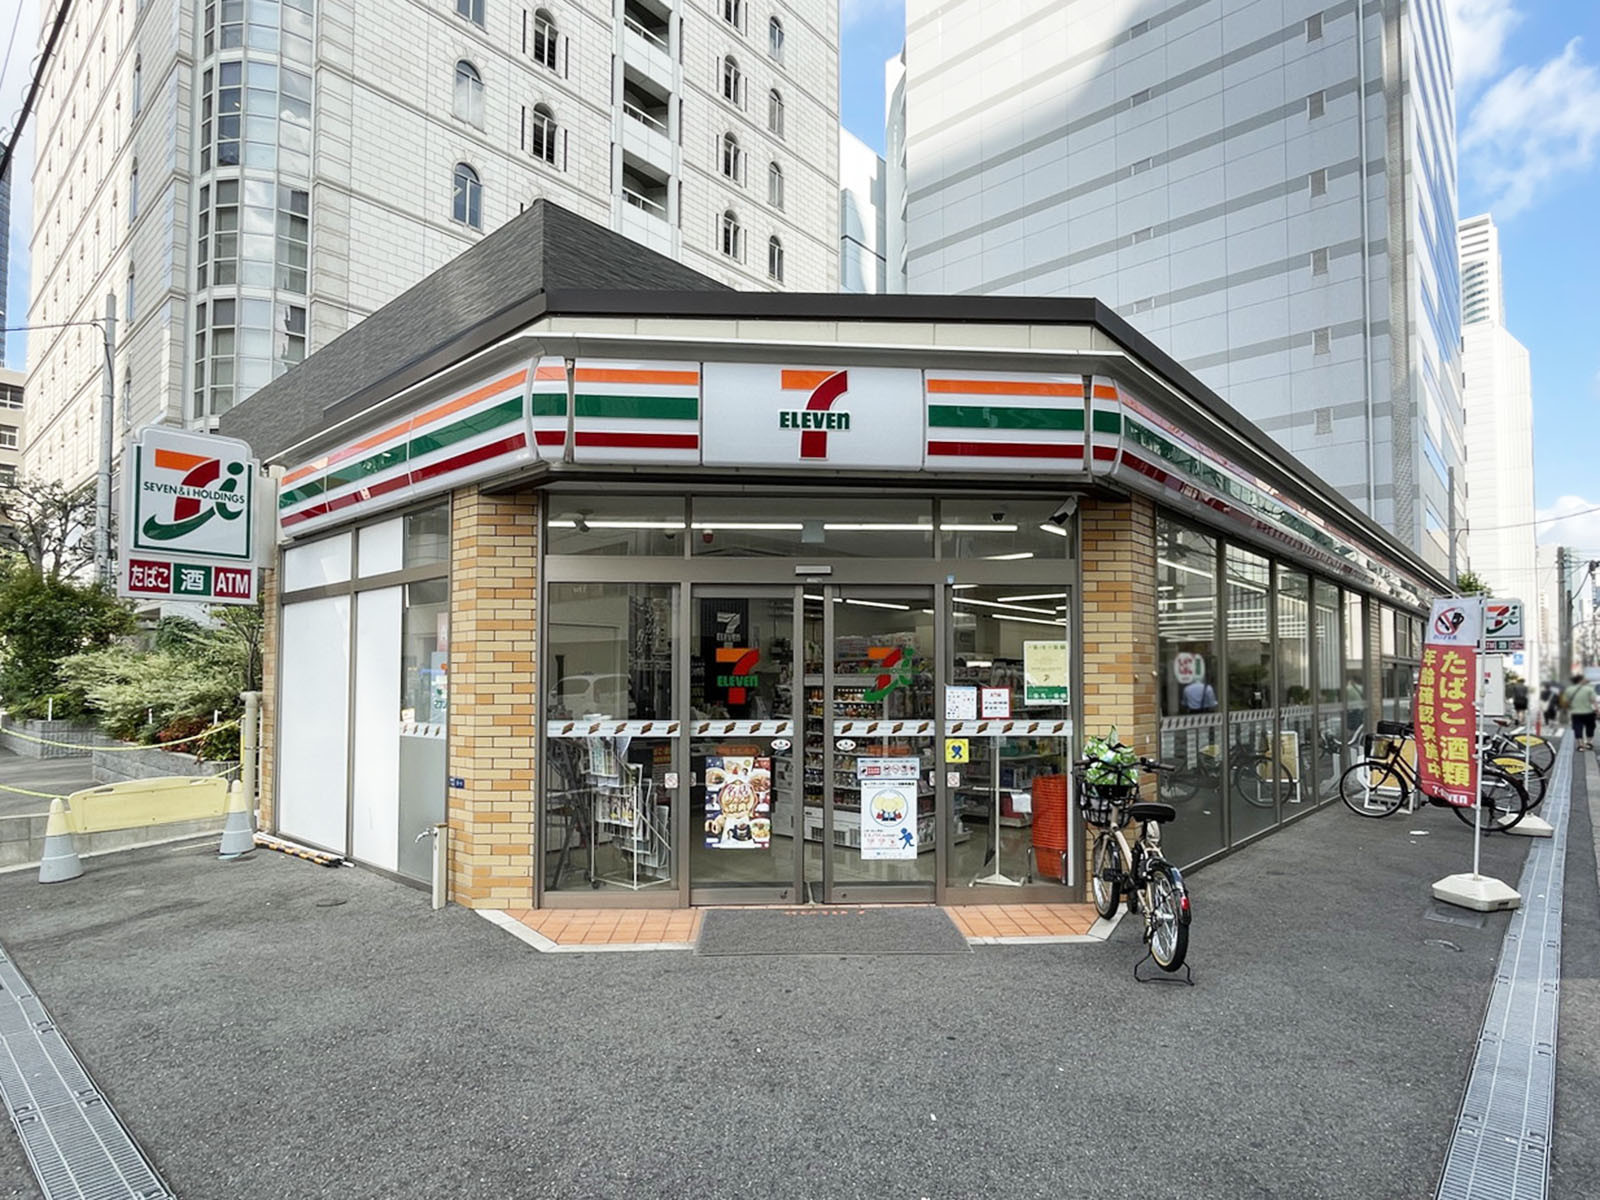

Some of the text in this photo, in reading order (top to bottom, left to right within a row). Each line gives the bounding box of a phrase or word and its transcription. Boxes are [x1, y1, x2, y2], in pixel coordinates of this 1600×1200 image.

[192, 489, 245, 504] HOLDINGS
[131, 564, 170, 588] たばこ
[180, 568, 206, 591] 酒
[216, 572, 249, 594] ATM
[1418, 648, 1443, 780] 年齢確認実施中
[1439, 650, 1471, 787] たばこ・酒類
